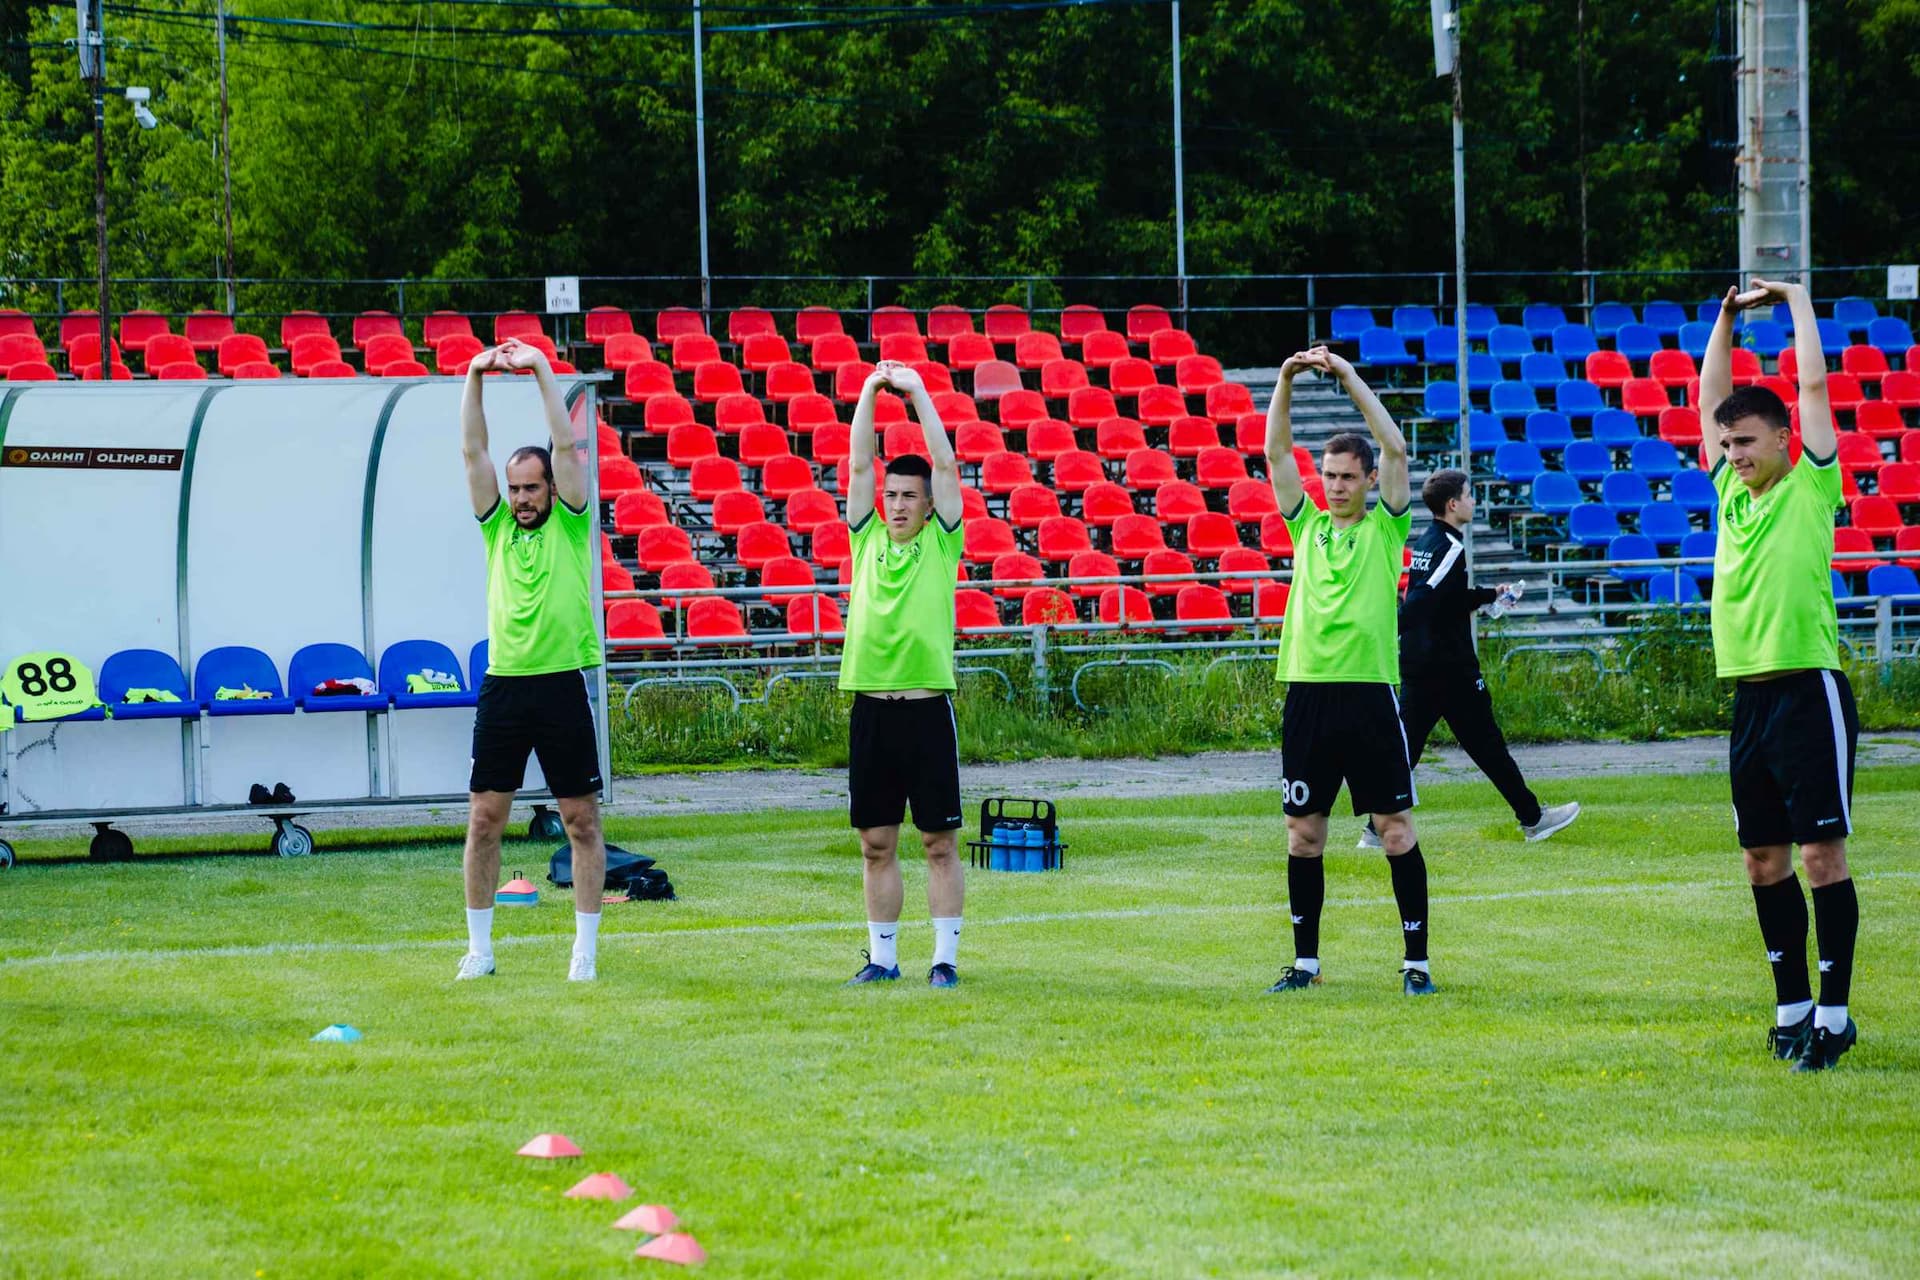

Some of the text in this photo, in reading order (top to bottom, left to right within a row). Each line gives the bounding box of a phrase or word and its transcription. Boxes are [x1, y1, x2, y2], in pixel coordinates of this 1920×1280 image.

[30, 451, 85, 461] ОЛИМП
[96, 453, 175, 465] OLIMP.BET
[17, 657, 77, 697] 88
